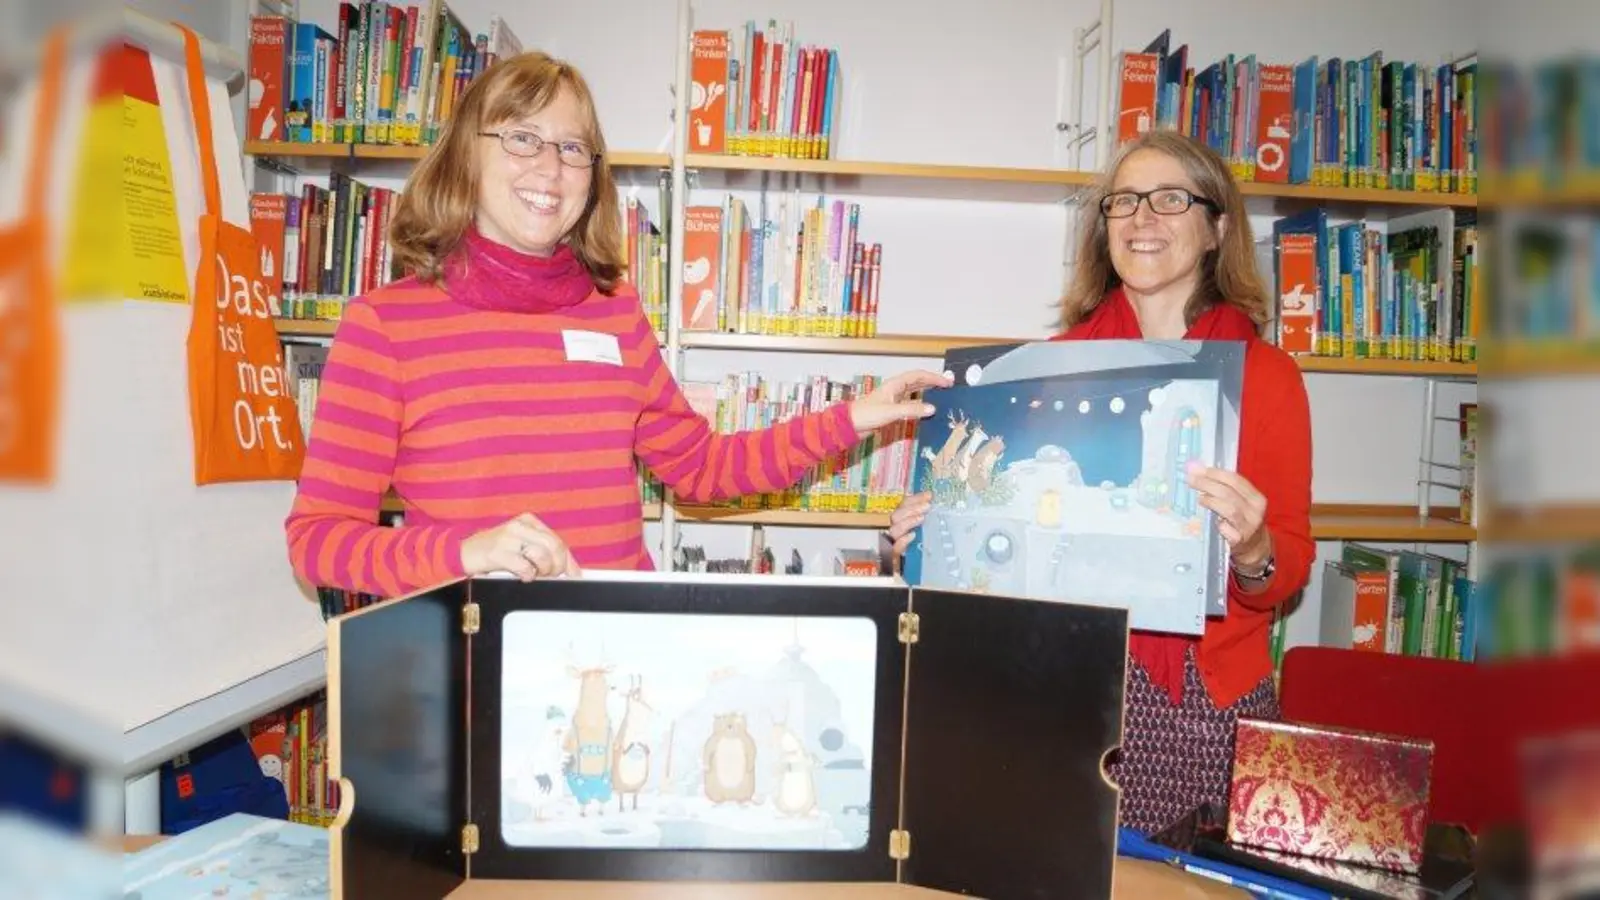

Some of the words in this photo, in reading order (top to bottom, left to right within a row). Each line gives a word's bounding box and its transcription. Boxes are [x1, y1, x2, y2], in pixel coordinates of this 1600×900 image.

[252, 33, 285, 45] Fakten
[695, 35, 718, 46] Essen
[695, 47, 728, 59] Trinken
[1124, 57, 1148, 69] Feste
[1123, 69, 1157, 83] Feiern
[1261, 70, 1283, 81] Natur
[252, 208, 286, 220] Denken
[686, 219, 720, 232] Bühne
[218, 314, 246, 354] ist
[234, 400, 293, 450] Ort.
[1356, 582, 1387, 595] Garten
